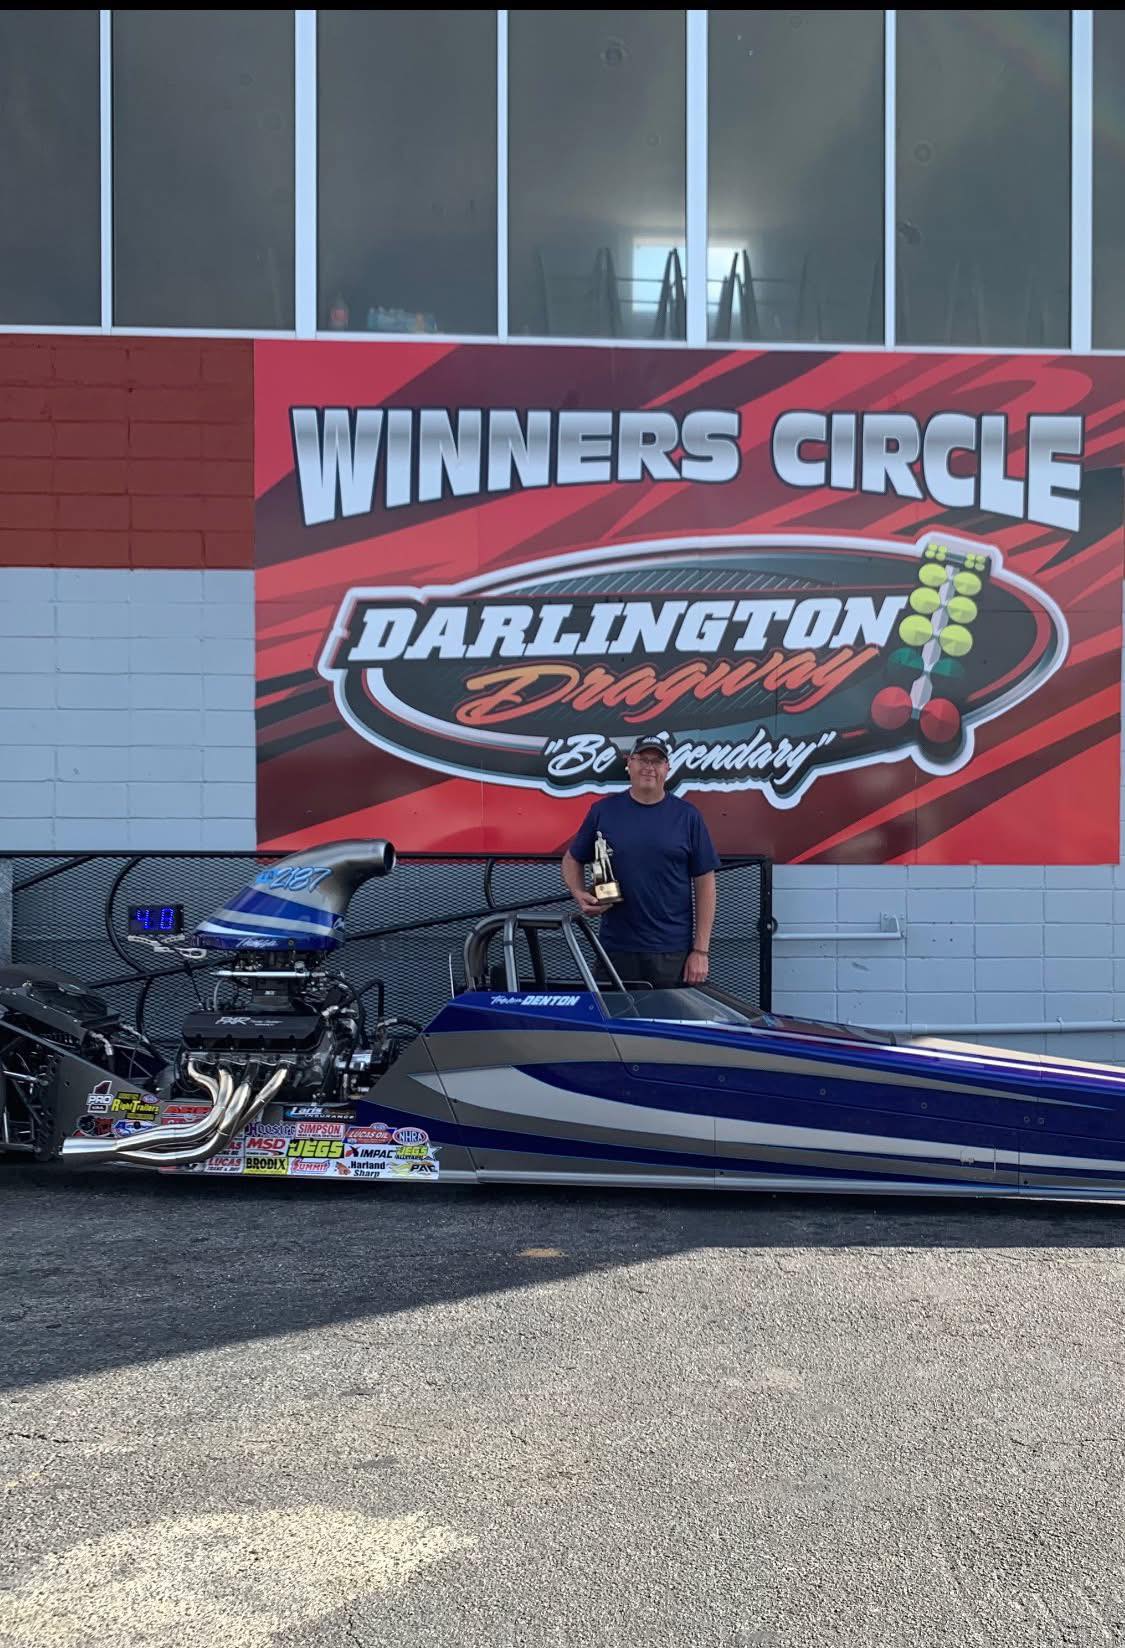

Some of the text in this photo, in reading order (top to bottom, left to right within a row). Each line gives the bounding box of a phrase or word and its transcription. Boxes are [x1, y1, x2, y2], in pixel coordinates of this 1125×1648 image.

[289, 406, 1084, 532] WINNERS CIRCLE
[348, 596, 909, 661] DARLINGTON
[456, 644, 881, 723] Dragway
[654, 728, 837, 785] gendary"
[521, 995, 580, 1006] DENTON
[87, 1095, 112, 1105] PRO
[299, 1123, 341, 1135] SIMPSON
[349, 1130, 374, 1139] LUCAS
[375, 1131, 388, 1139] OIL
[398, 1131, 423, 1143] NHRA
[247, 1138, 286, 1150] MSD
[288, 1140, 344, 1158] JEGS
[396, 1146, 428, 1155] JEGS
[208, 1157, 242, 1167] LUCAS
[246, 1157, 286, 1170] BRODIX
[351, 1160, 386, 1170] Harland
[409, 1163, 438, 1173] PAC
[354, 1169, 380, 1178] Sharp
